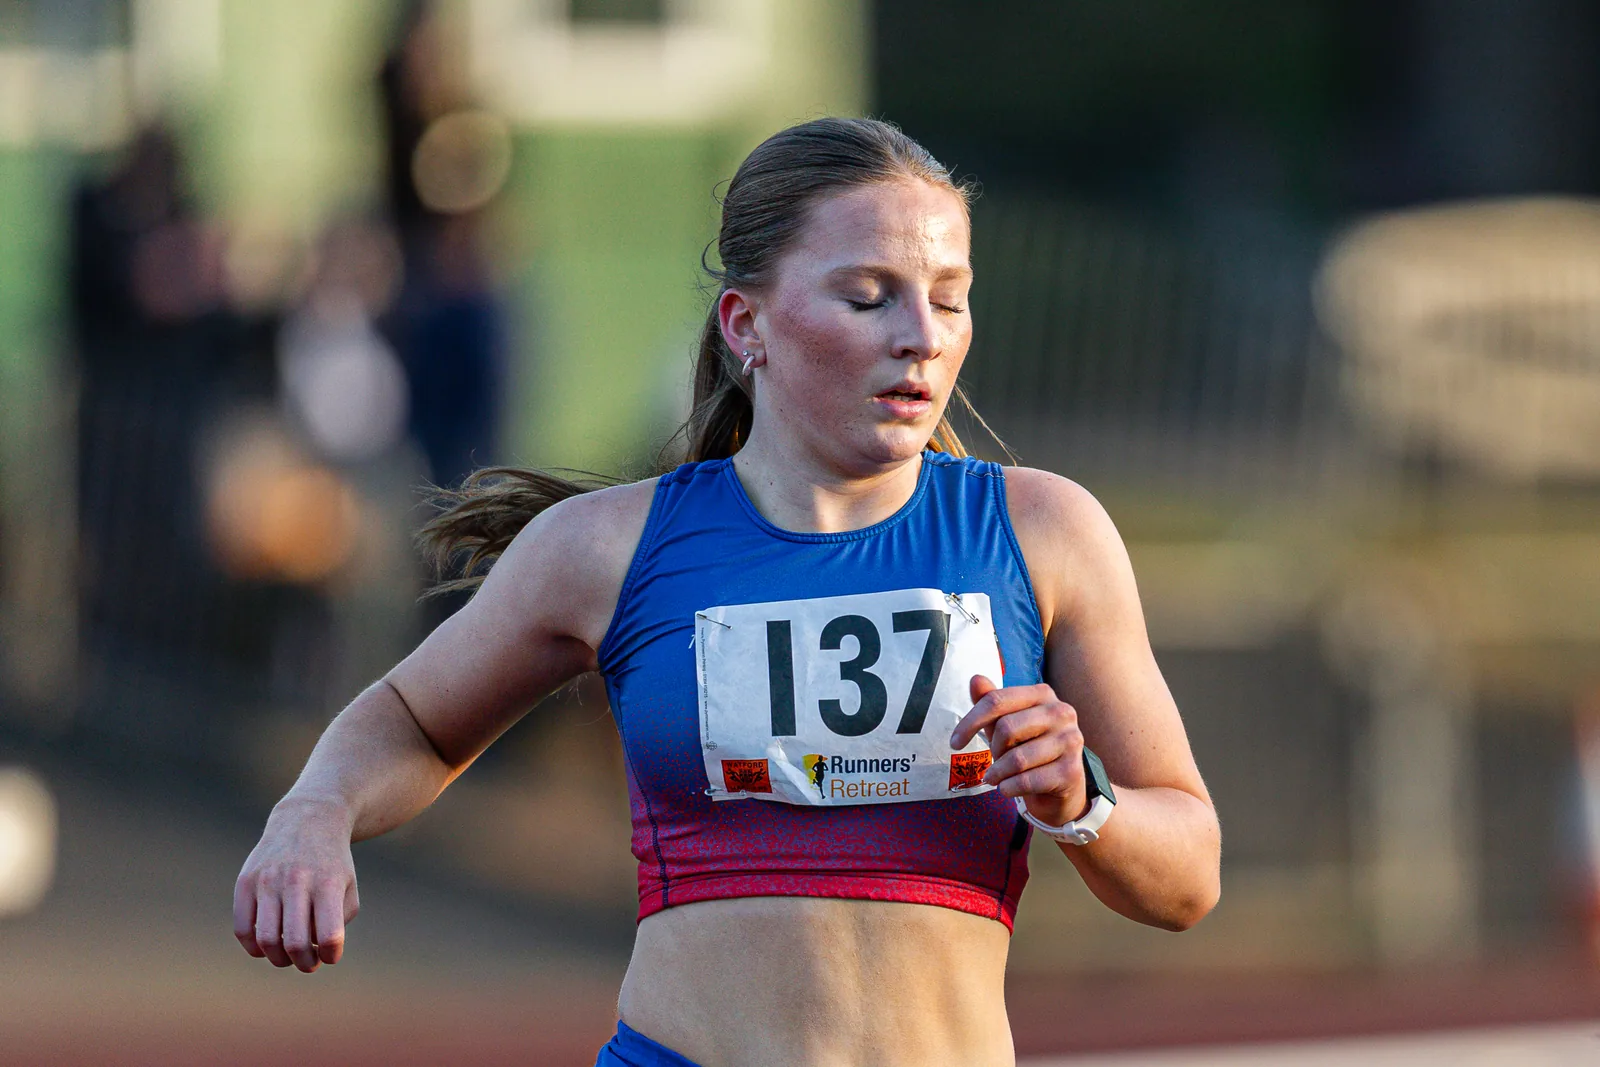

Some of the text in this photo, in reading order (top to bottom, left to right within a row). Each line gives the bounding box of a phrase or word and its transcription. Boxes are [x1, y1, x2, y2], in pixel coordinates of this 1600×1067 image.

[766, 609, 951, 737] 137
[830, 754, 917, 774] Runners'
[955, 752, 989, 762] WATFORD
[830, 778, 910, 798] Retreat
